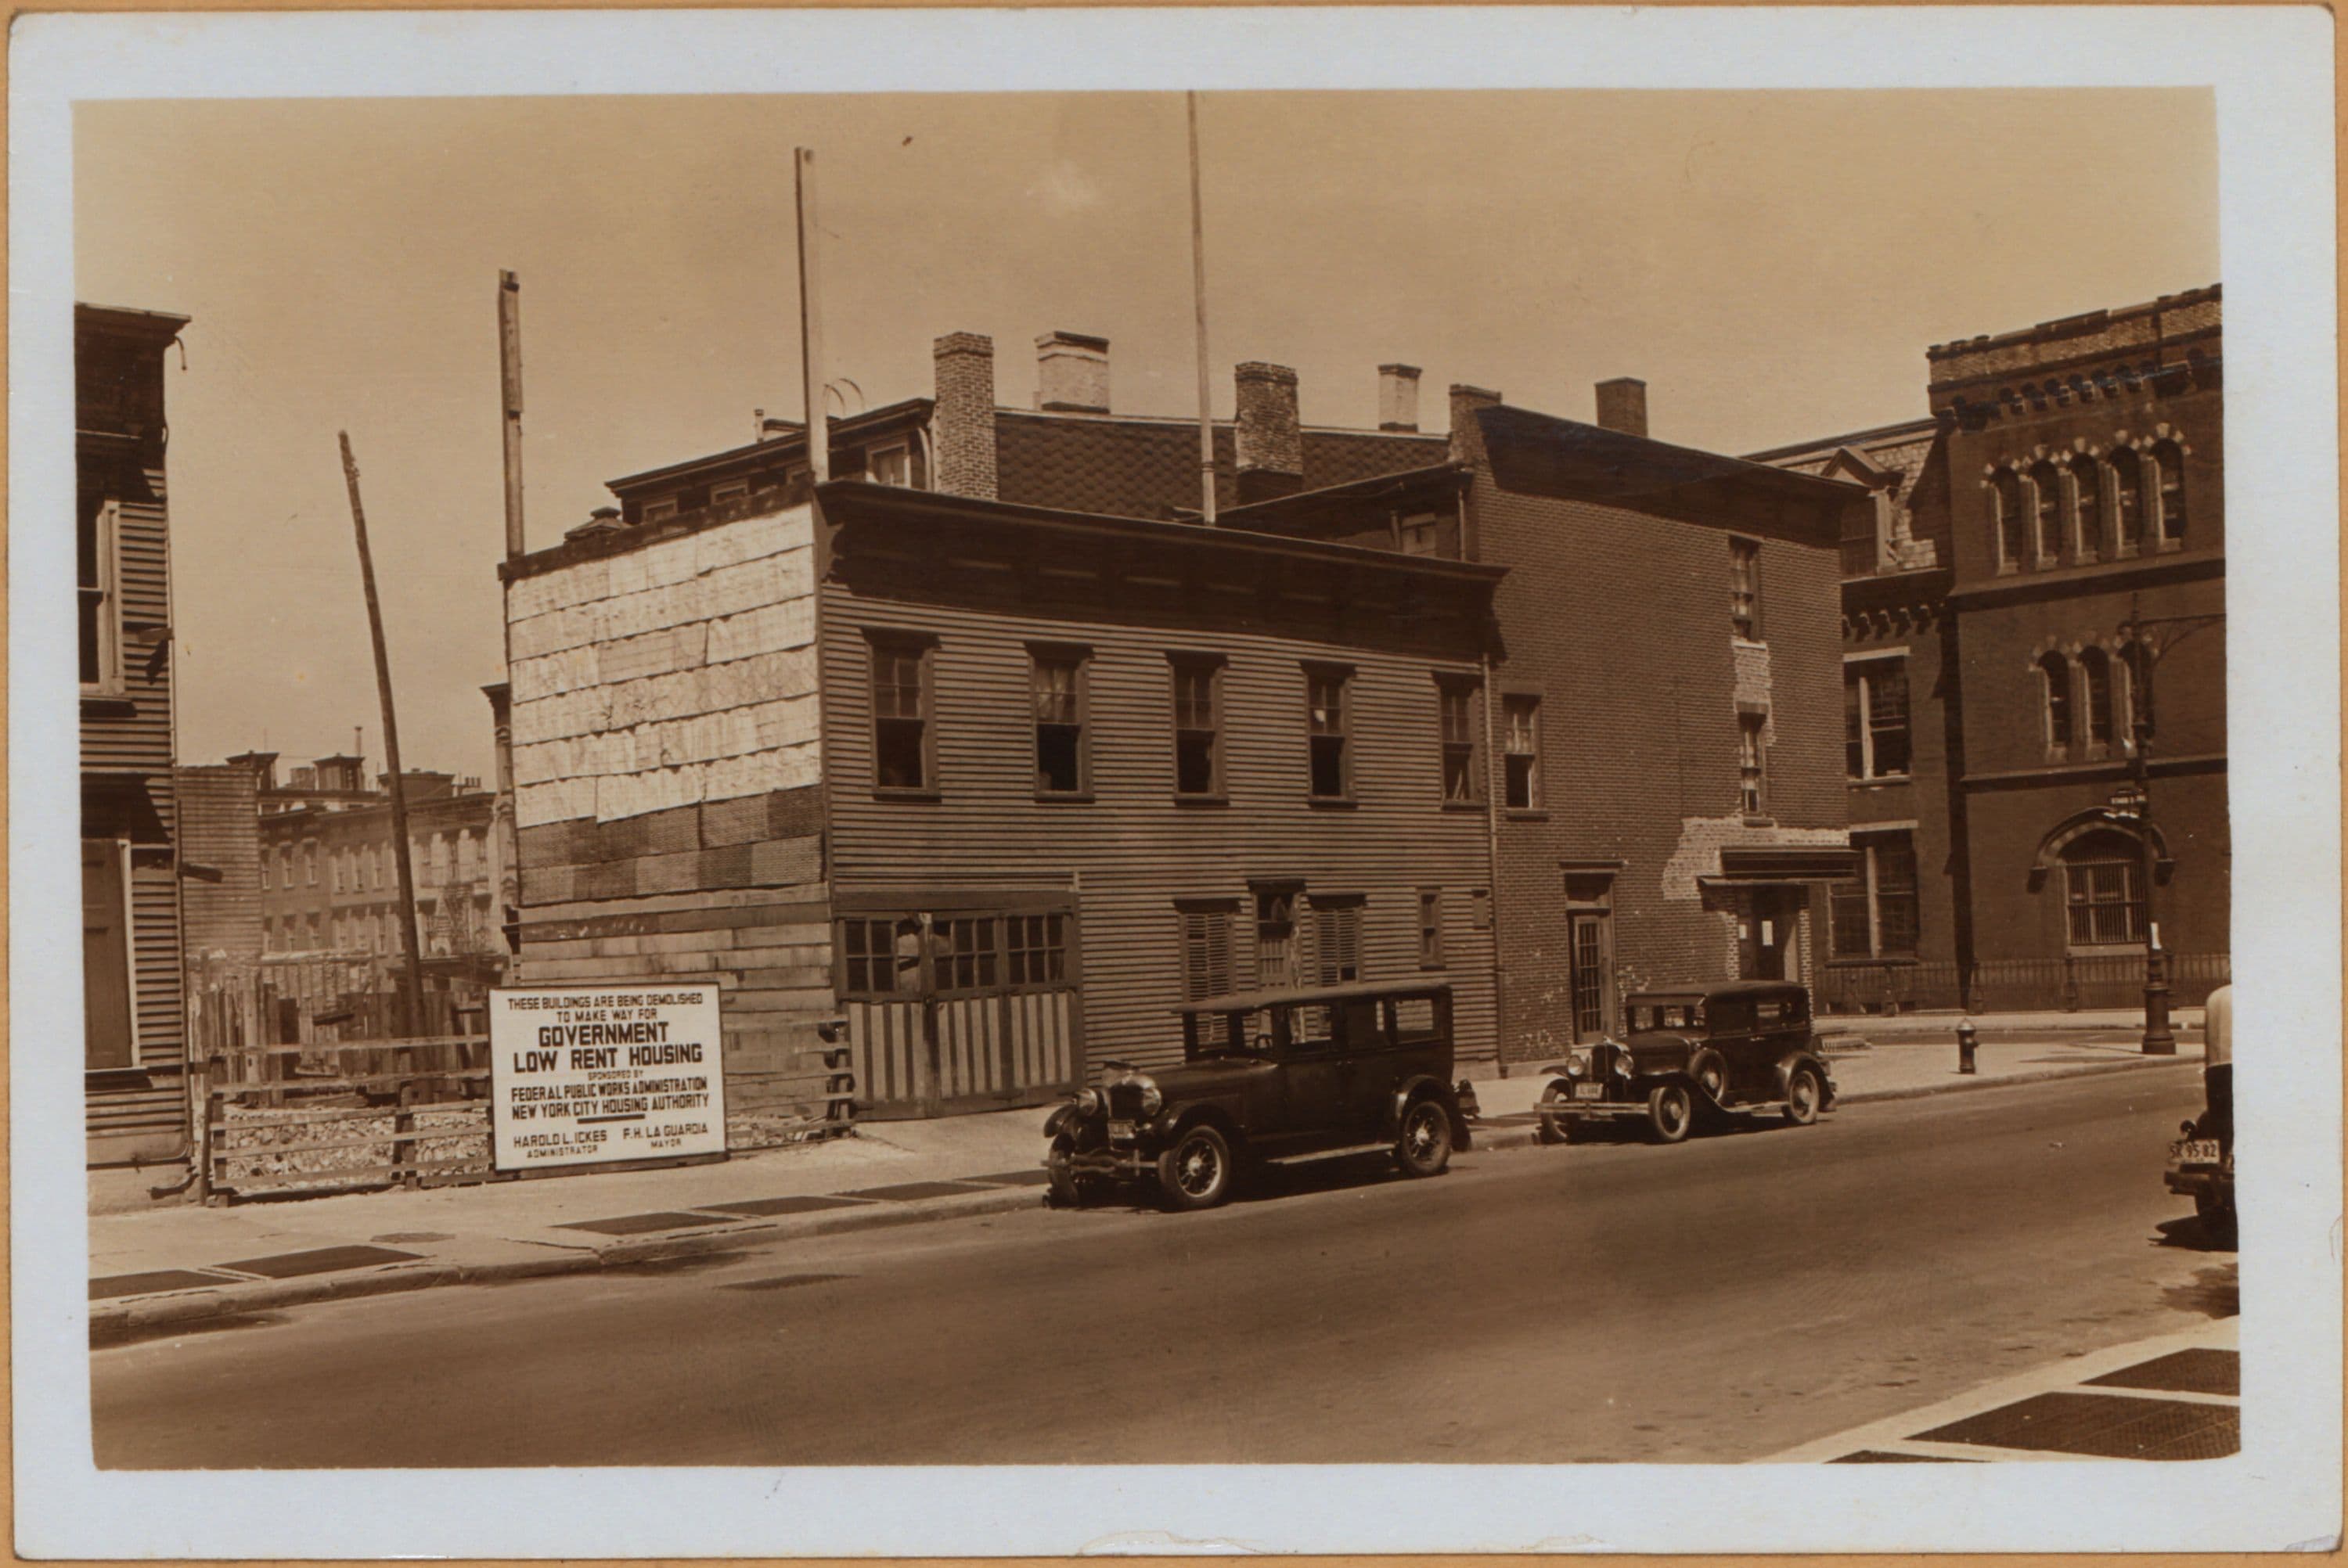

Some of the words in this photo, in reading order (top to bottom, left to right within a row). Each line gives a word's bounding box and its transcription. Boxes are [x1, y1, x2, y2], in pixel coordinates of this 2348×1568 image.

[508, 998, 539, 1010] THESE
[542, 996, 591, 1009] BUILDINGS
[593, 995, 614, 1008] ARE
[617, 994, 643, 1007] BEING
[646, 992, 703, 1005] DEMOLISHED
[556, 1011, 571, 1023] TO
[574, 1009, 607, 1022] MAKE
[612, 1009, 633, 1020] WAY
[639, 1008, 657, 1020] FOR
[538, 1021, 669, 1047] GOVERNMENT
[513, 1050, 557, 1073] LOW
[571, 1047, 618, 1070] RENT
[629, 1043, 703, 1066] HOUSING
[588, 1070, 631, 1081] SPONSORED
[633, 1069, 643, 1079] BY
[511, 1085, 563, 1102] FEDERAL
[564, 1083, 596, 1099] PUBLIC
[598, 1081, 630, 1097] WORKS
[632, 1076, 708, 1094] ADMINISTRATION
[512, 1104, 536, 1120] NEW
[541, 1102, 571, 1118] YORK
[573, 1100, 598, 1116] CITY
[602, 1096, 648, 1114] HOUSING
[651, 1093, 709, 1111] AUTHORITY
[513, 1133, 560, 1148] HAROLD
[562, 1132, 573, 1145] L.
[574, 1130, 607, 1143] ICKES
[646, 1126, 661, 1138] LA
[663, 1122, 708, 1137] GUARDIA
[527, 1144, 598, 1158] ADMINISTRATOR
[650, 1138, 682, 1149] MAYOR
